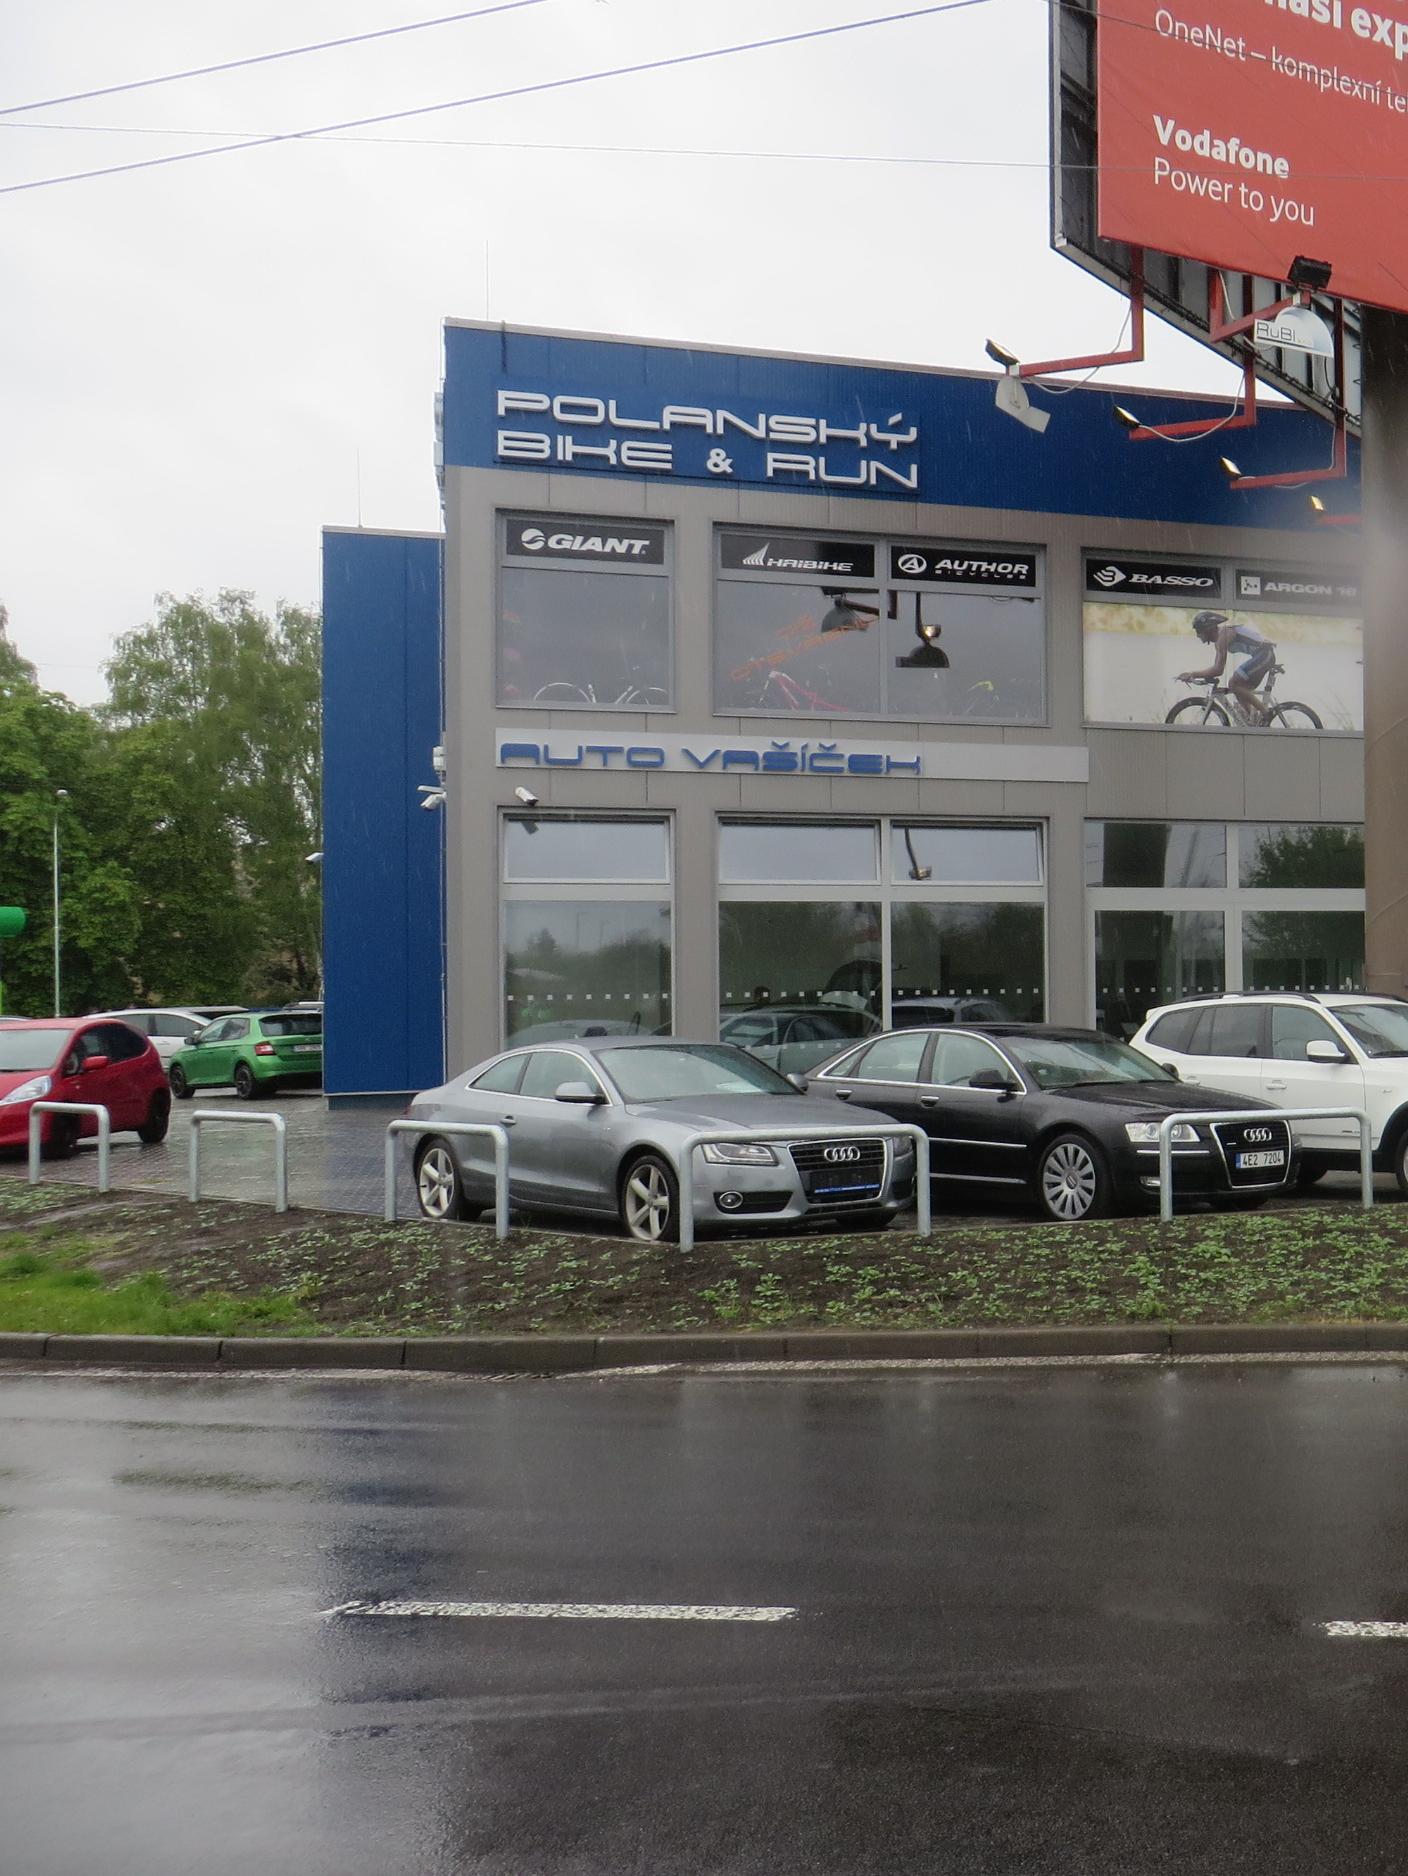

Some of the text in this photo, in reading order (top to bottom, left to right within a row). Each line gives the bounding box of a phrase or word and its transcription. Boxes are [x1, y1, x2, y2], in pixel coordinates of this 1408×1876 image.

[1154, 9, 1247, 61] OneNet
[1271, 46, 1382, 105] komplexní
[1152, 114, 1290, 178] Vodafone
[1154, 157, 1315, 227] Power to you
[497, 389, 918, 450] POLANSKÝ
[497, 430, 918, 489] BIKE & RUN
[547, 533, 650, 555] GIANT
[766, 557, 854, 572] HAIBIKE
[934, 559, 1029, 575] AUTHOR
[1128, 573, 1214, 588] BASSO
[1264, 582, 1333, 596] ARGON
[499, 740, 922, 775] AUTO VAŠÍČEK
[1243, 1154, 1258, 1166] 4E2
